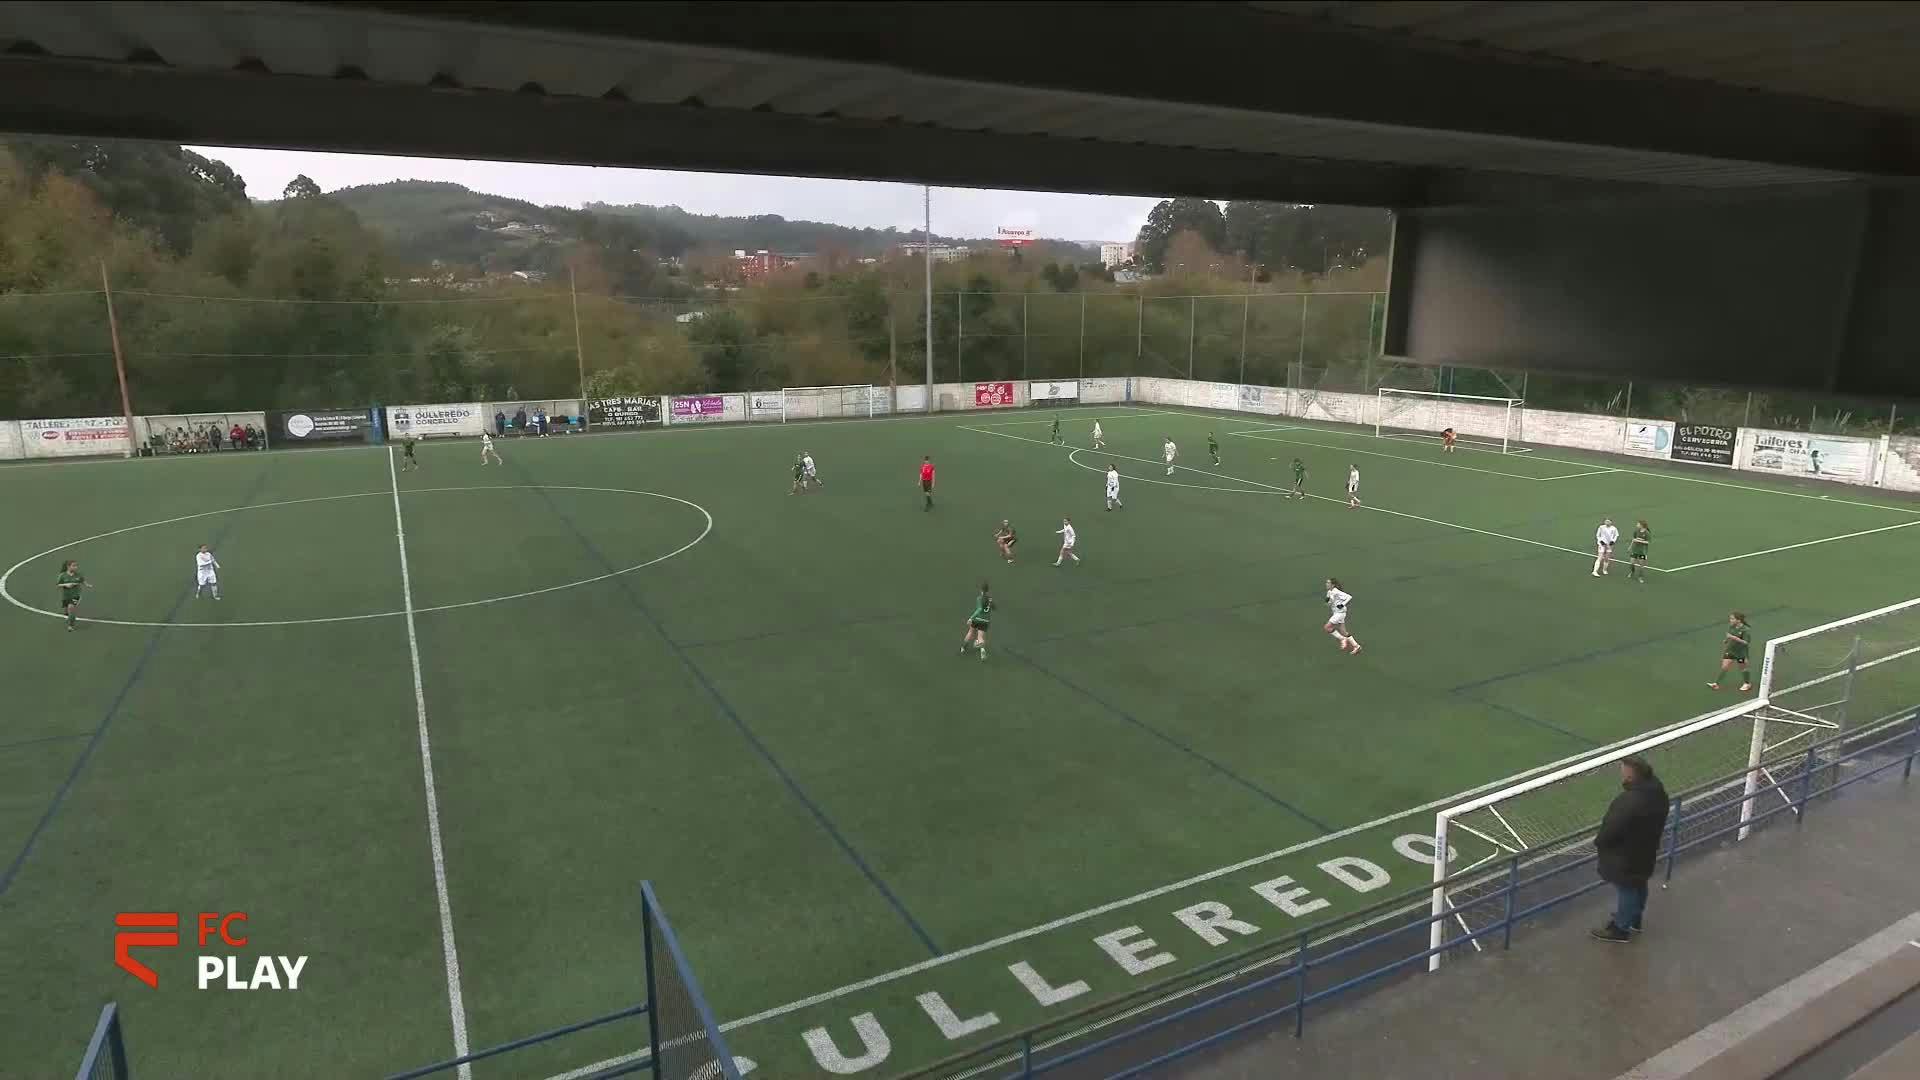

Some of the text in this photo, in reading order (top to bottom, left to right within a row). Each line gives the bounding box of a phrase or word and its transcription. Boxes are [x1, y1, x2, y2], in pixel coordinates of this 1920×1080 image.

[601, 398, 622, 407] TRES
[623, 397, 657, 408] MARIAS
[1679, 426, 1732, 440] EL POTRO
